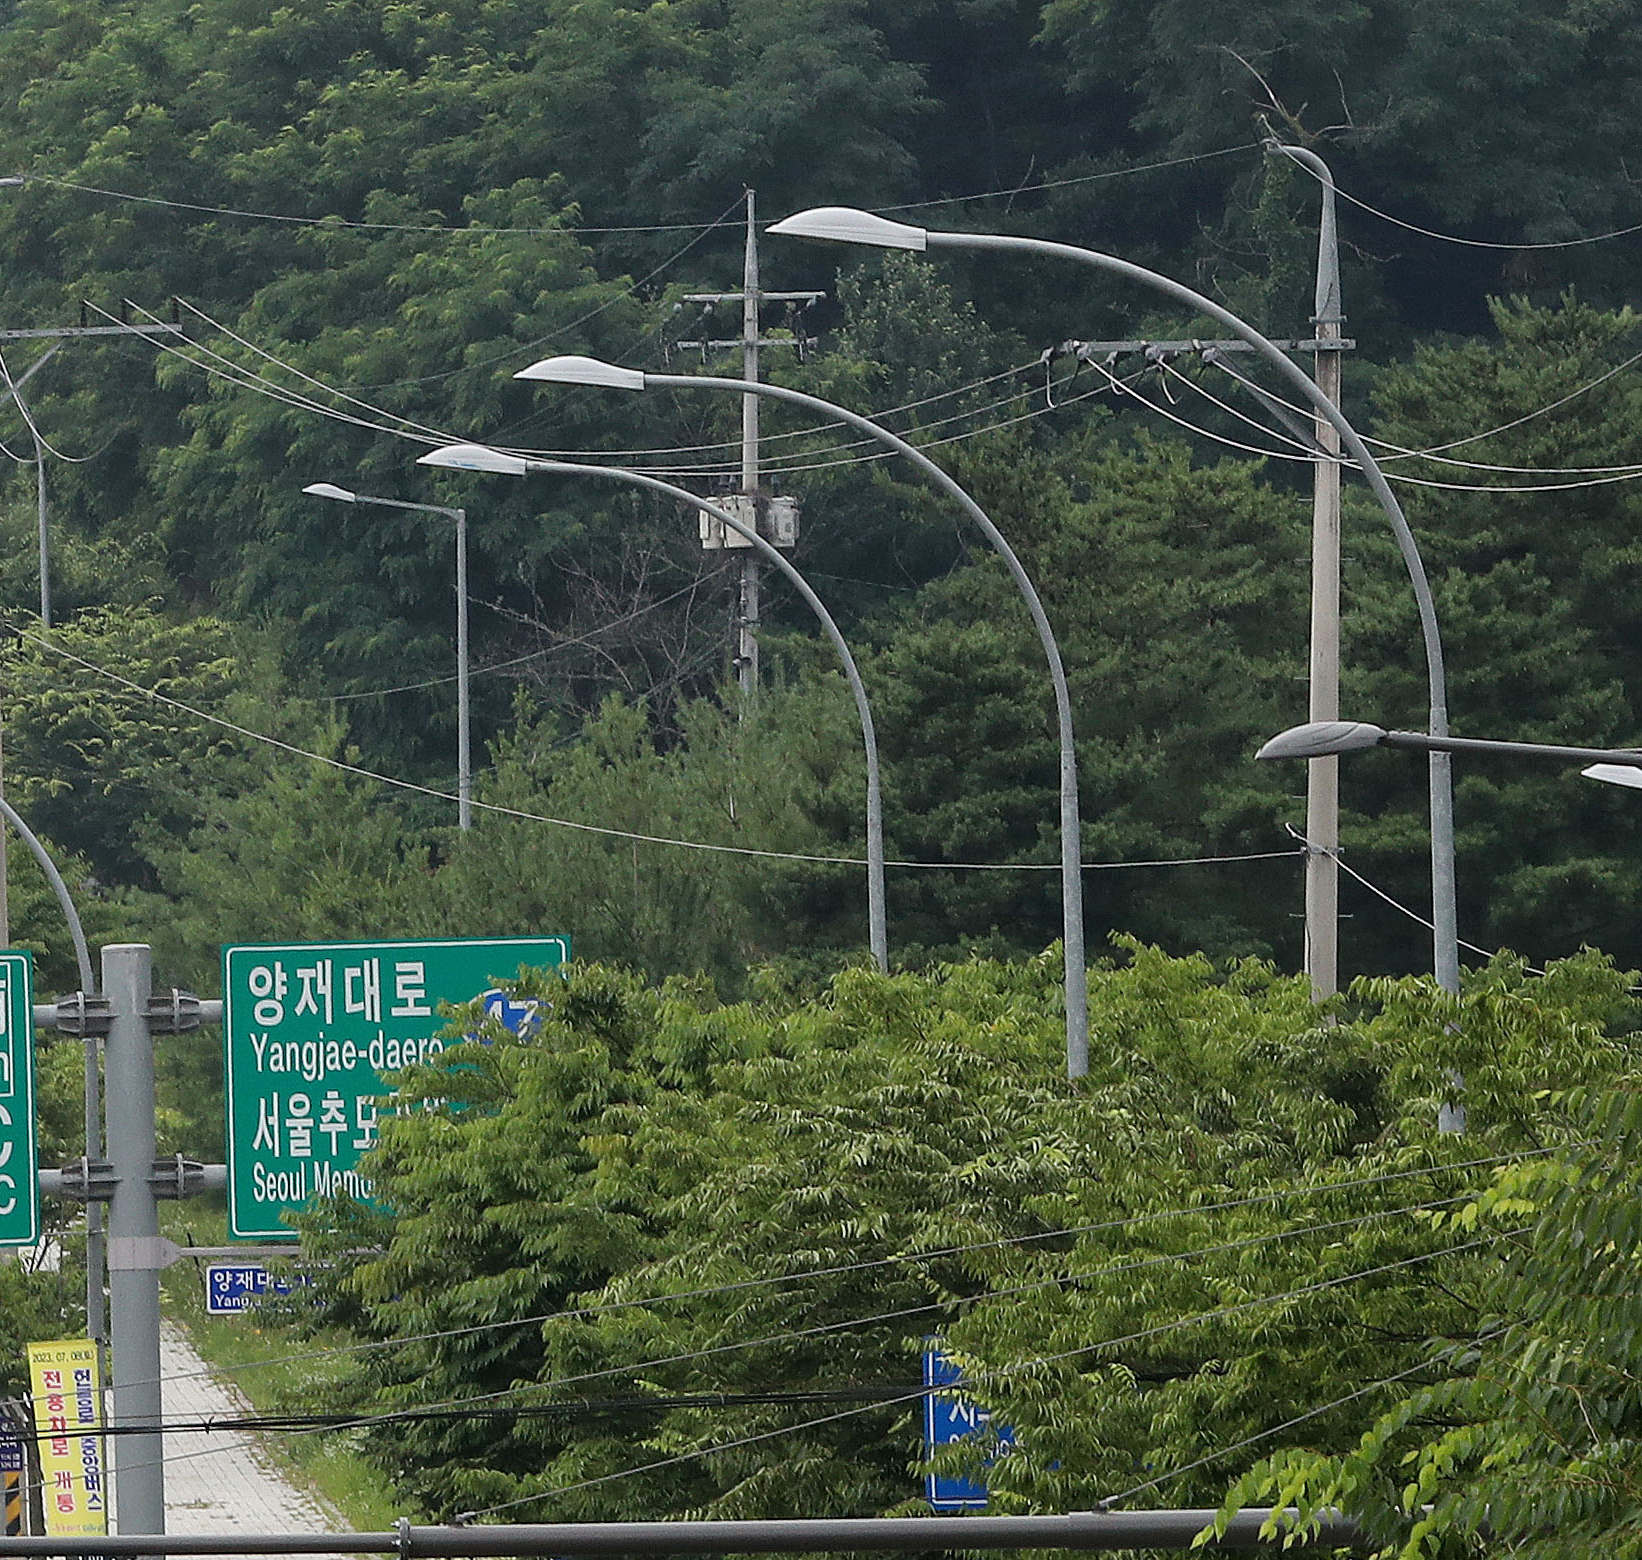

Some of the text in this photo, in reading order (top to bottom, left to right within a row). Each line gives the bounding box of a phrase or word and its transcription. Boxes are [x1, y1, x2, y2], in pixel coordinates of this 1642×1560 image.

[248, 958, 433, 1027] 양재대로
[252, 1161, 306, 1203] Seoul
[54, 1470, 75, 1514] 개통
